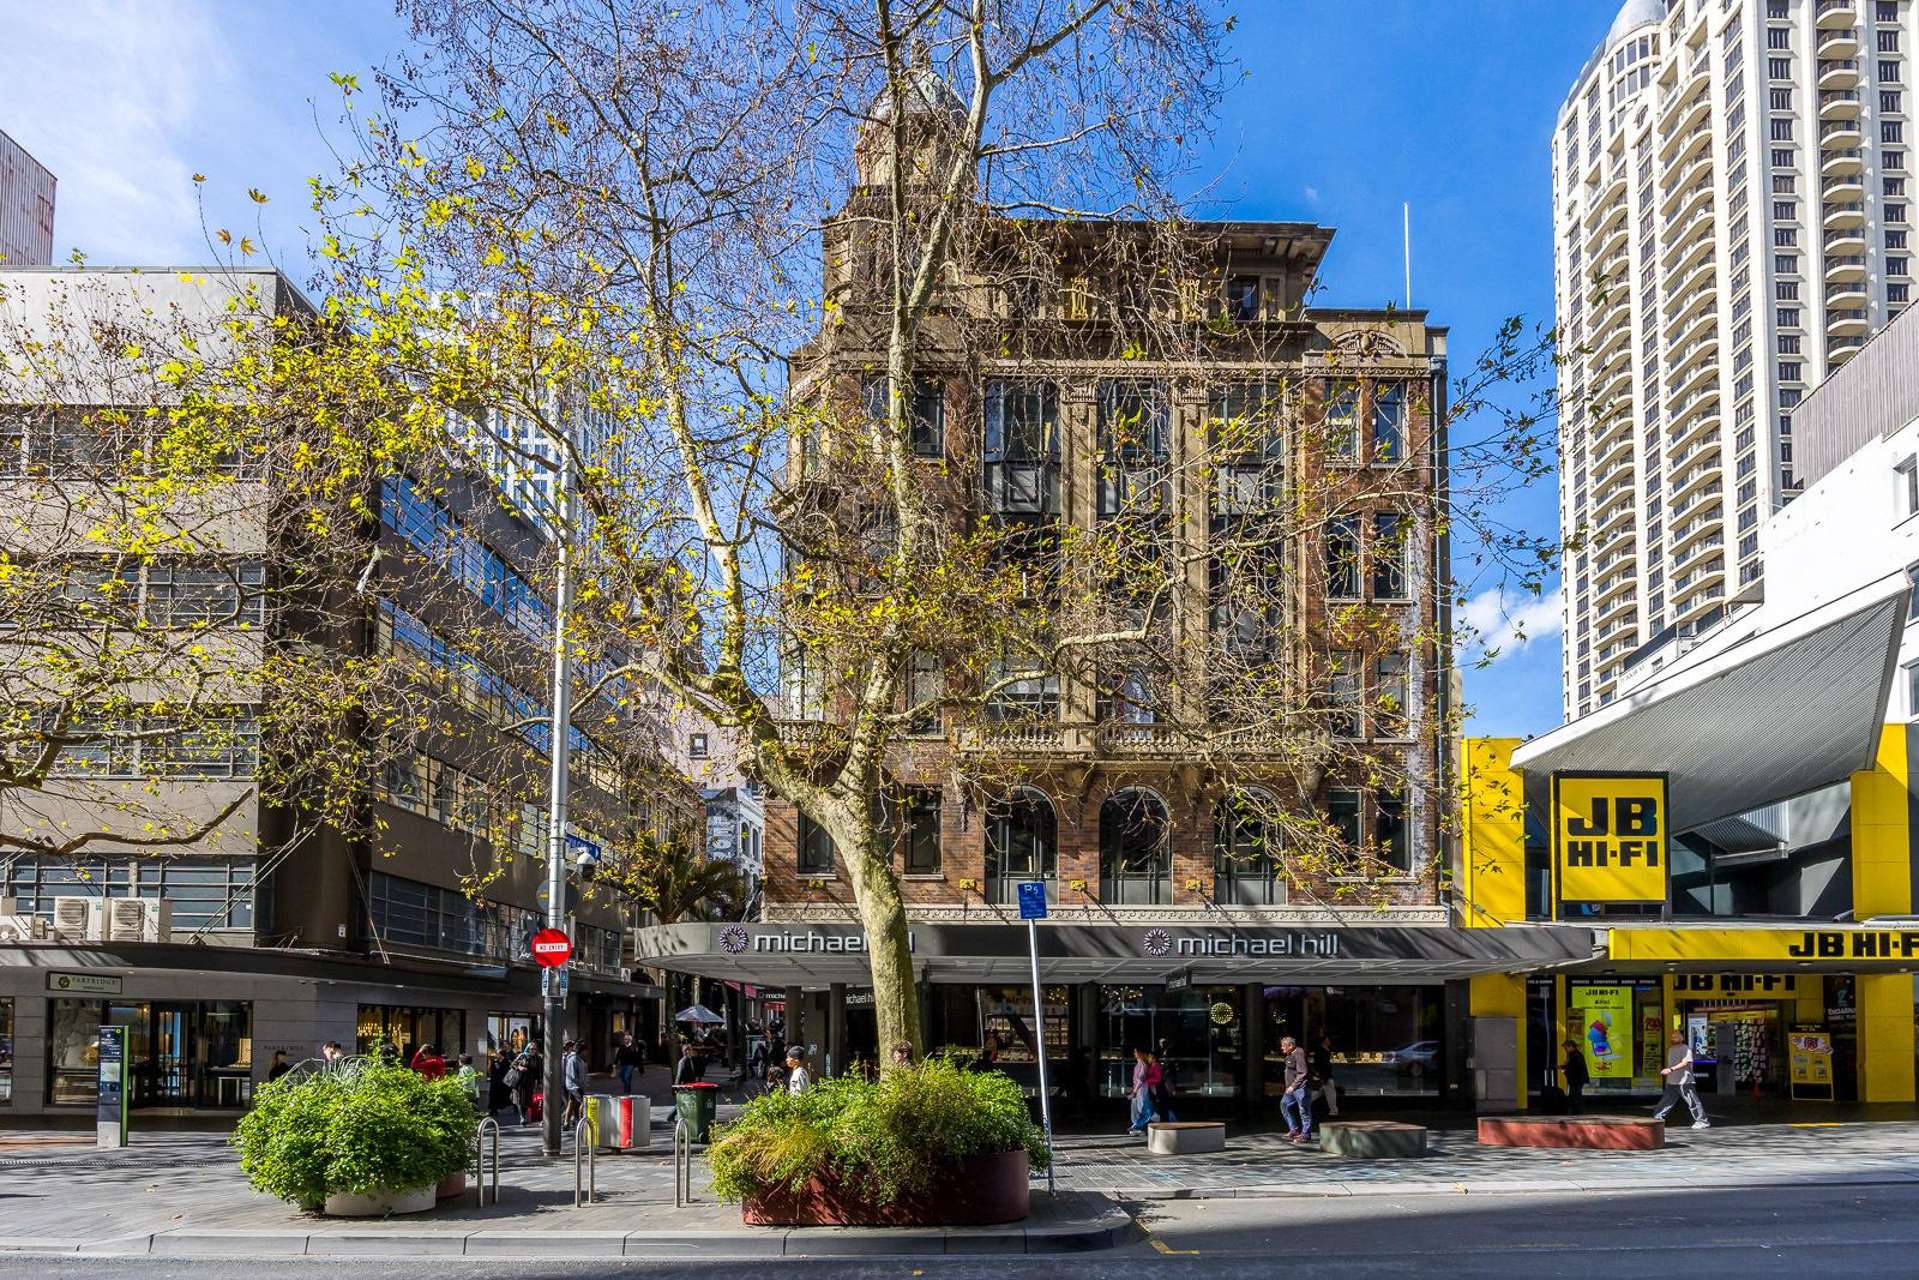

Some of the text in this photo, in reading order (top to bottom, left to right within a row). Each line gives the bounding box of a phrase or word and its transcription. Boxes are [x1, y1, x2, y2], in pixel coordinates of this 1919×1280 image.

[1567, 797, 1657, 836] JB
[1567, 841, 1658, 867] HI-FI
[754, 930, 868, 951] michael
[1177, 933, 1339, 955] michael hill
[1788, 932, 1919, 957] JB HI-F
[1673, 974, 1713, 991] JB
[845, 992, 867, 1004] ichael
